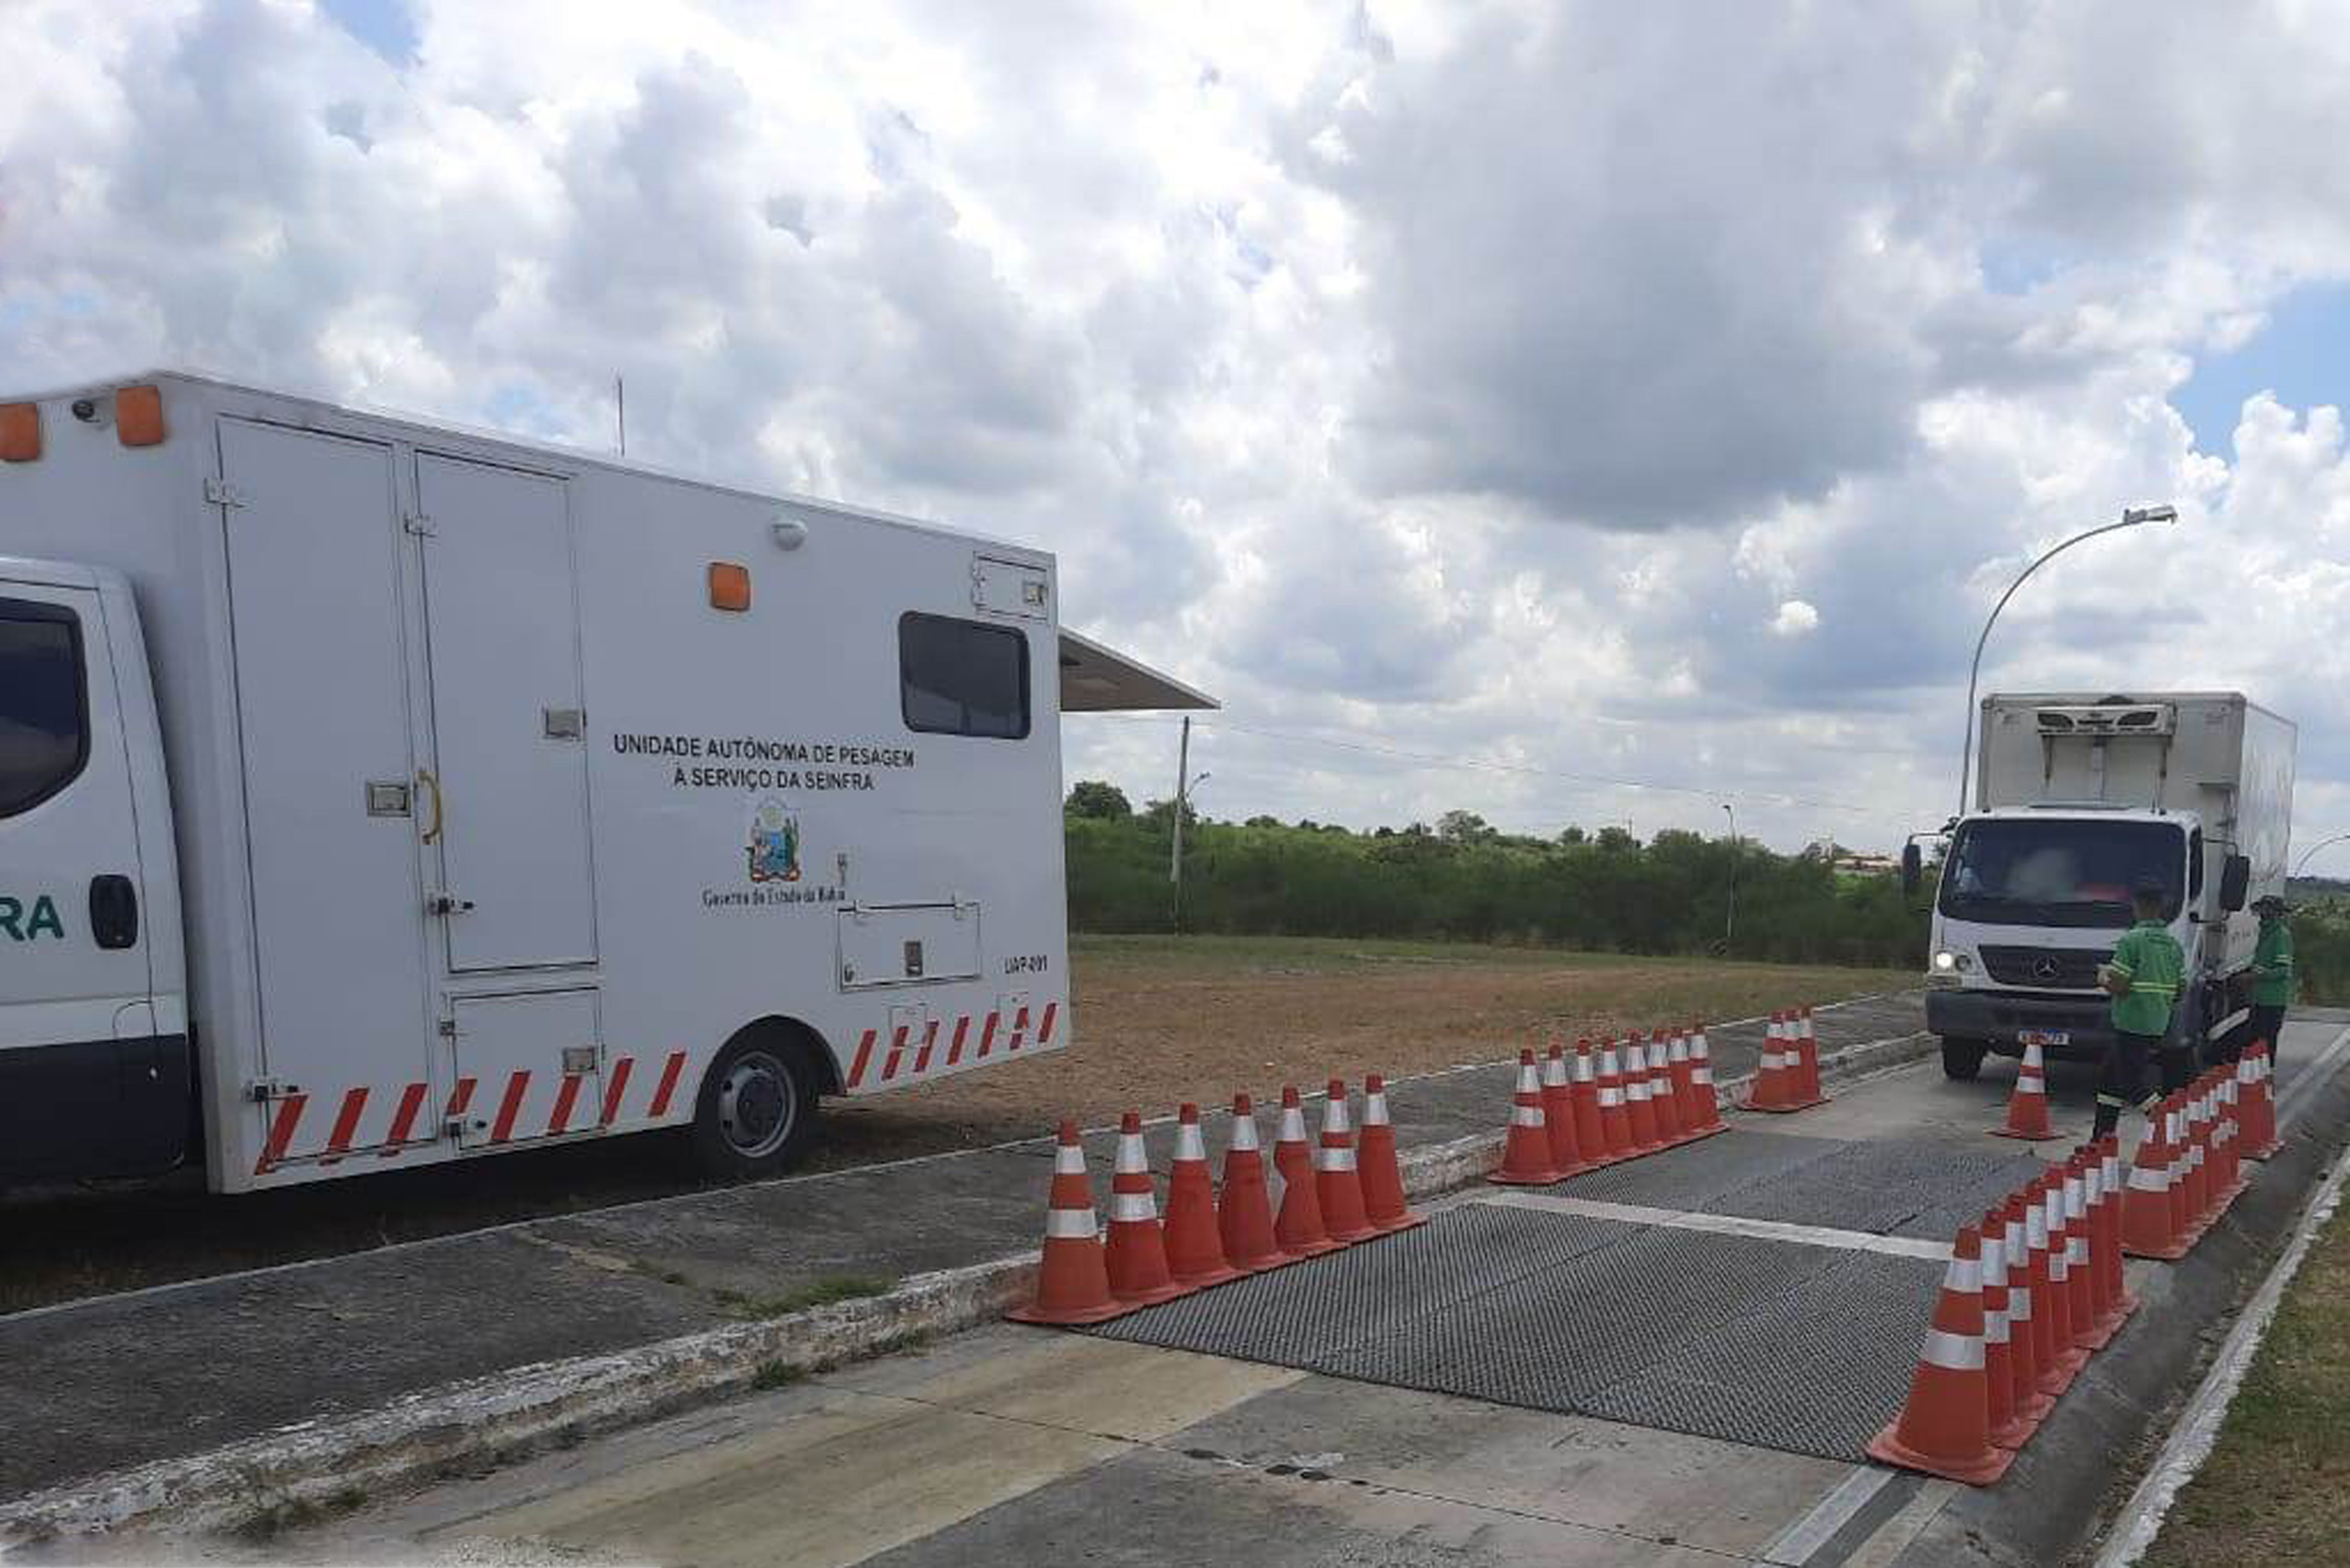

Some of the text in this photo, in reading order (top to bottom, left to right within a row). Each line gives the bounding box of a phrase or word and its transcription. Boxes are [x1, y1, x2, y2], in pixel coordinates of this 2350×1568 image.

[614, 734, 914, 767] UNIDADE AUTÔNOMA DE PESAGEM
[692, 767, 771, 792] SERVIÇO
[777, 770, 801, 788] DA
[805, 771, 874, 790] SEINFRA
